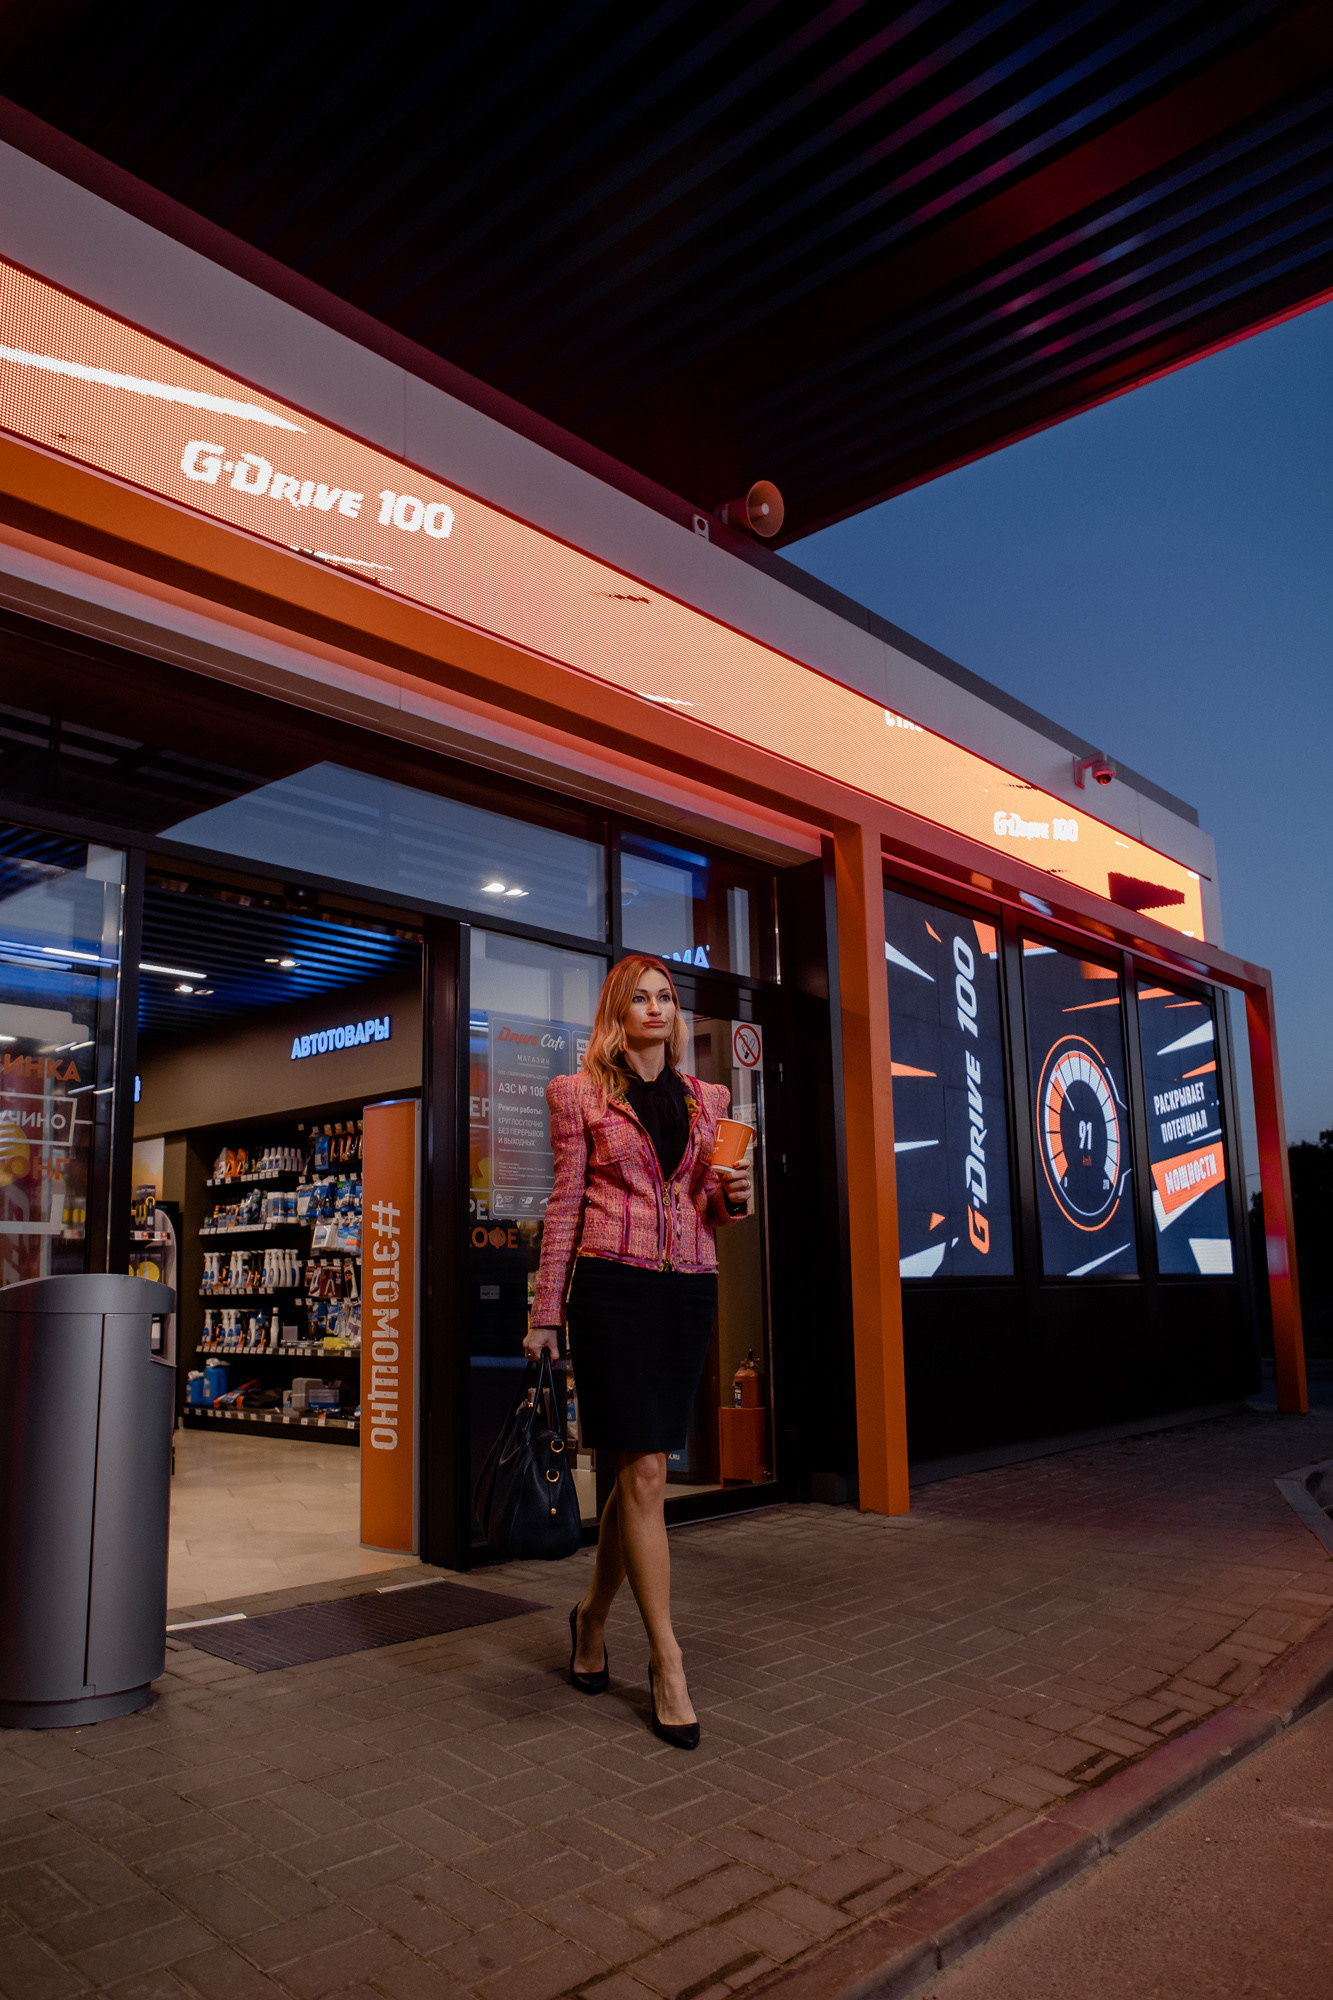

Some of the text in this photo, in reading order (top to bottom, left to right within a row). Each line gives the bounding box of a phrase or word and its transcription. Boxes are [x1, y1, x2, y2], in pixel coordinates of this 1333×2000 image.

[378, 490, 455, 539] 100
[1052, 818, 1079, 842] 100
[953, 936, 978, 1038] 100
[290, 1016, 389, 1060] АВТОТОВАРЫ
[541, 1034, 565, 1051] Cafe
[0, 1054, 81, 1082] ИНКА
[517, 1054, 550, 1065] МАГАЗИН
[498, 1082, 516, 1094] АЗС
[530, 1086, 544, 1097] 108
[1153, 1082, 1205, 1115] РАСКРЫВАЕТ
[498, 1103, 518, 1113] Режим
[1079, 1120, 1092, 1150] 91
[1161, 1109, 1208, 1143] ПОТЕНЦИАЛ
[1165, 1153, 1217, 1195] МОЩНОСТИ
[469, 1227, 518, 1249] ОФЕ
[367, 1200, 400, 1450] #ЭТОМОЩНО
